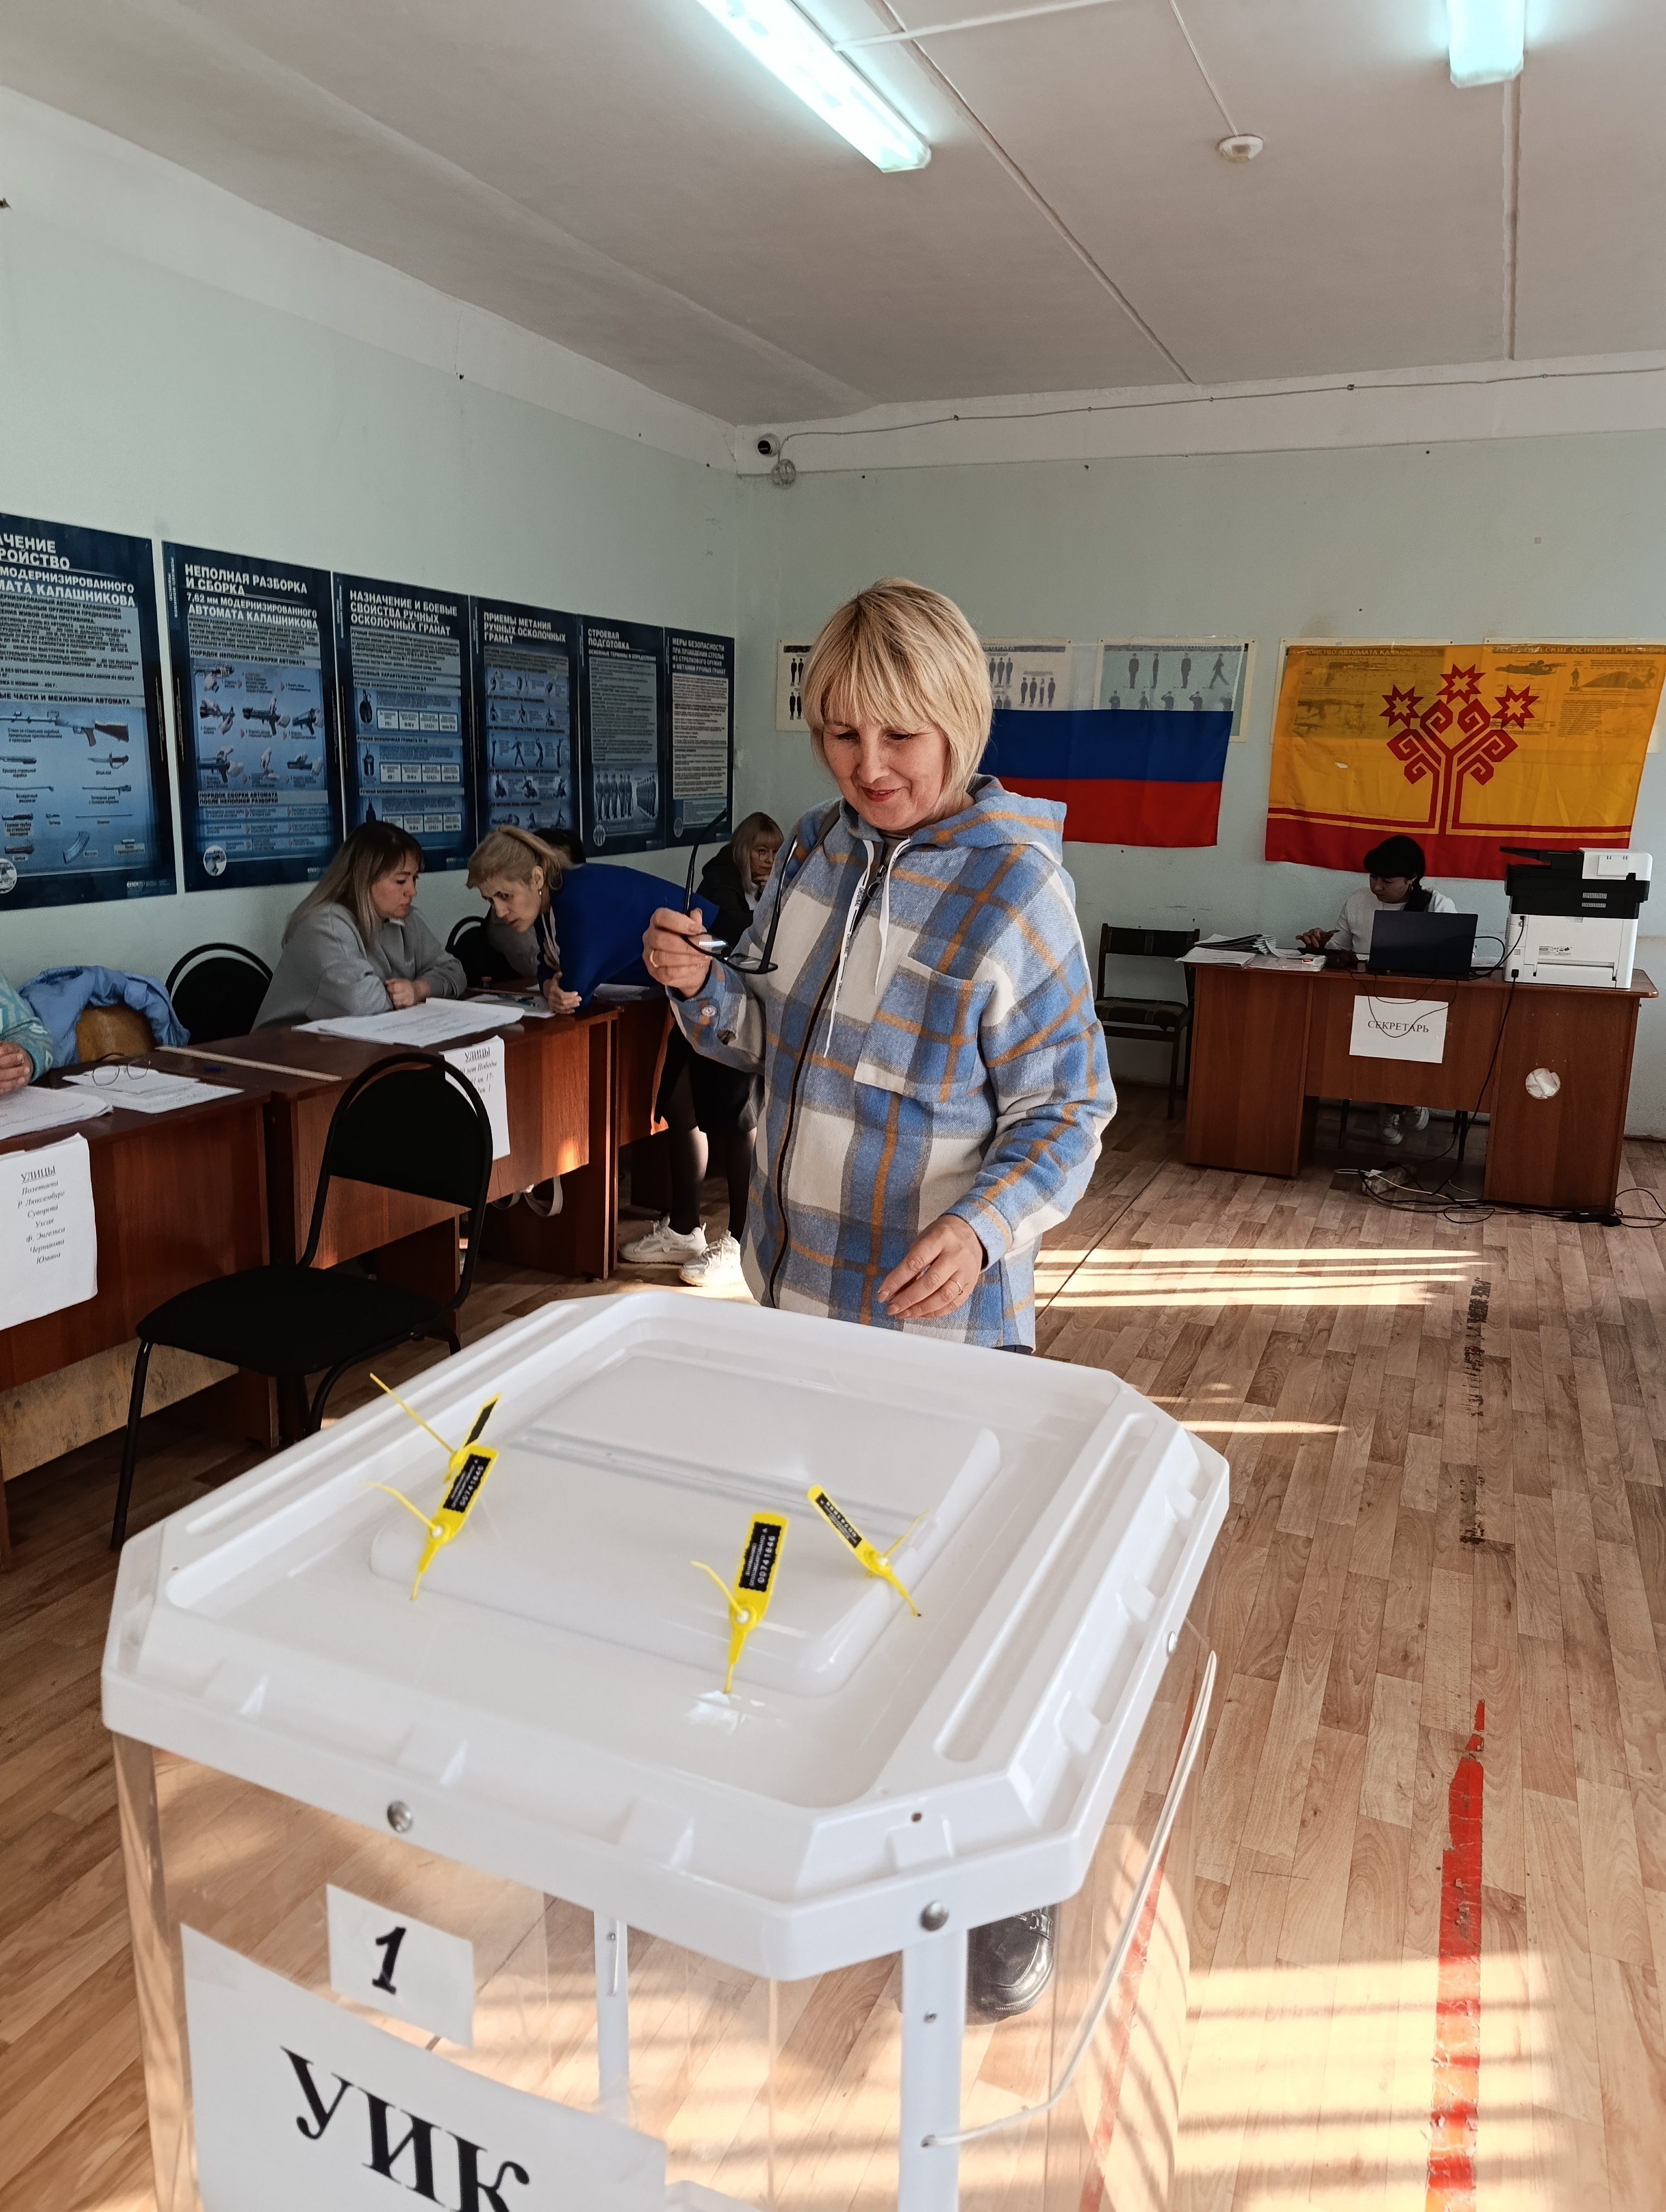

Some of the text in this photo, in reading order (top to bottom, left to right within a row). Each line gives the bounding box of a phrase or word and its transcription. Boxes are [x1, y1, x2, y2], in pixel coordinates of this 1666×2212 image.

[0, 566, 134, 594] МОДЕРНИЗИРОВАННОГО
[184, 563, 307, 594] НЕПОЛНАЯ РАЗБОРКА
[186, 576, 245, 596] И СБОРКА
[36, 584, 135, 607] КАЛАШНИКОВА
[350, 589, 457, 616] НАЗНАЧЕНИЕ И БОЕВЫЕ
[56, 598, 81, 608] АВТОМАТ
[82, 603, 121, 613] КАЛАШНИКОВА
[187, 591, 204, 603] 7,62
[221, 596, 317, 619] МОДЕРНИЗИРОВАННОГО
[350, 601, 439, 624] СВОЙСТВА РУЧНЫХ
[189, 603, 318, 629] АВТОМАТА КАЛАШНИКОВА
[484, 611, 552, 631] ПРИЕМЫ МЕТАНИЯ
[351, 614, 451, 636] ОСКОЛОЧНЫХ ГРАНАТ
[484, 621, 566, 643] РУЧНЫХ ОСКОЛОЧНЫХ
[484, 632, 513, 645] ГРАНАТ
[588, 628, 619, 640] СТРОЕВАЯ
[588, 637, 630, 650] ПОДГОТОВКА
[672, 637, 725, 652] МЕРЫ БЕЗОПАСНОСТИ
[190, 649, 305, 666] ПОРЯДОК НЕПОЛНОЙ РАЗБОРКИ АВТОМАТА
[48, 695, 93, 704] МЕХАНИЗМЫ
[1368, 1020, 1429, 1033] СЕКРЕТАРЬ
[465, 1046, 490, 1062] УЛИЦЫ
[477, 1060, 497, 1071] Победы
[21, 1165, 56, 1182] УЛИЦЫ
[22, 1180, 58, 1195] Полетаева
[18, 1191, 65, 1209] Р. Люксембург
[27, 1205, 58, 1219] Суворова
[36, 1218, 54, 1229] Ухсая
[36, 1226, 65, 1240] Энгельса
[30, 1238, 65, 1253] Черникова
[36, 1251, 61, 1265] Юмана
[757, 1534, 776, 1584] 00741846
[372, 1926, 408, 1995] 1
[280, 2046, 530, 2212] УИК
